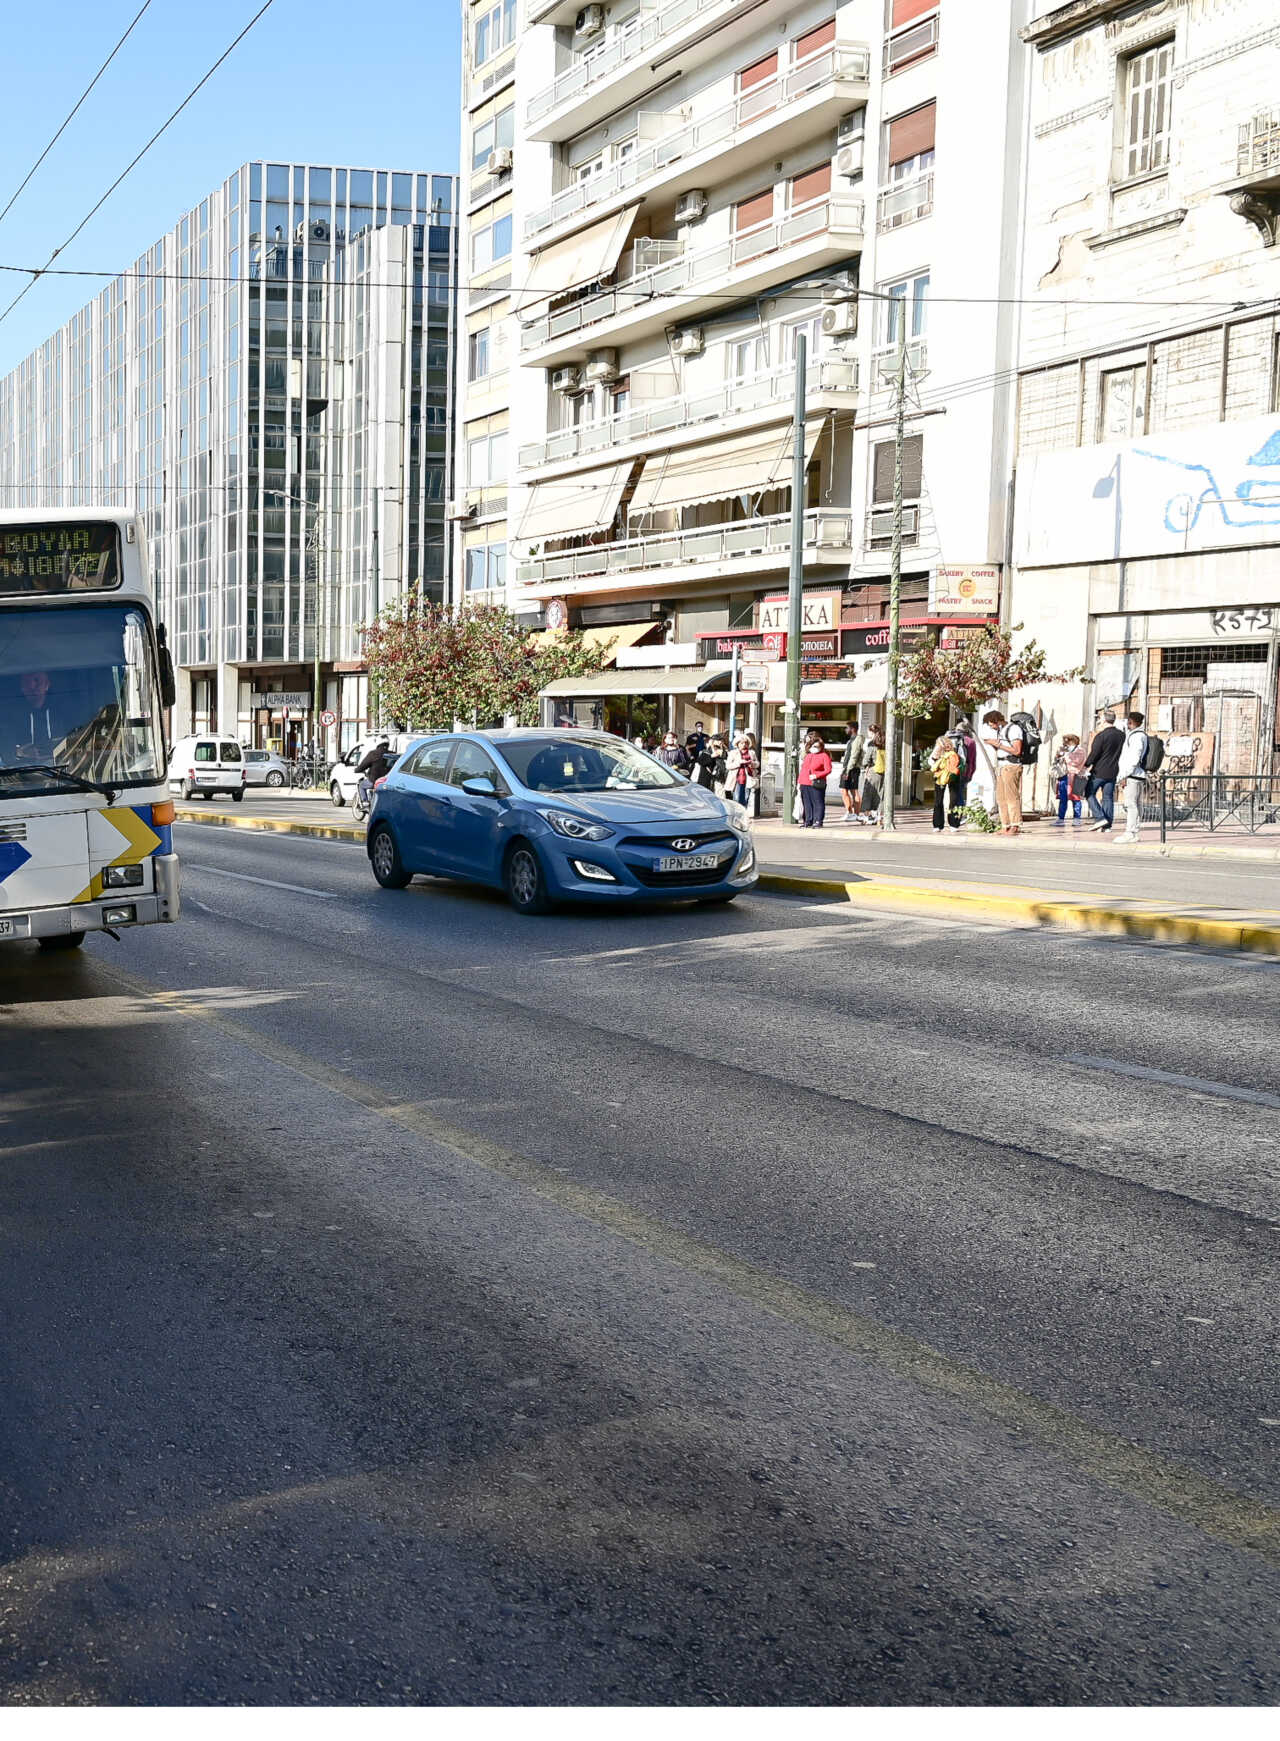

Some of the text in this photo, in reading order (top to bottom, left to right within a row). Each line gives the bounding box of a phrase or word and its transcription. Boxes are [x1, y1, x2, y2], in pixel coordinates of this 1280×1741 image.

[865, 630, 891, 646] coff
[268, 693, 302, 705] ALPHA BANK
